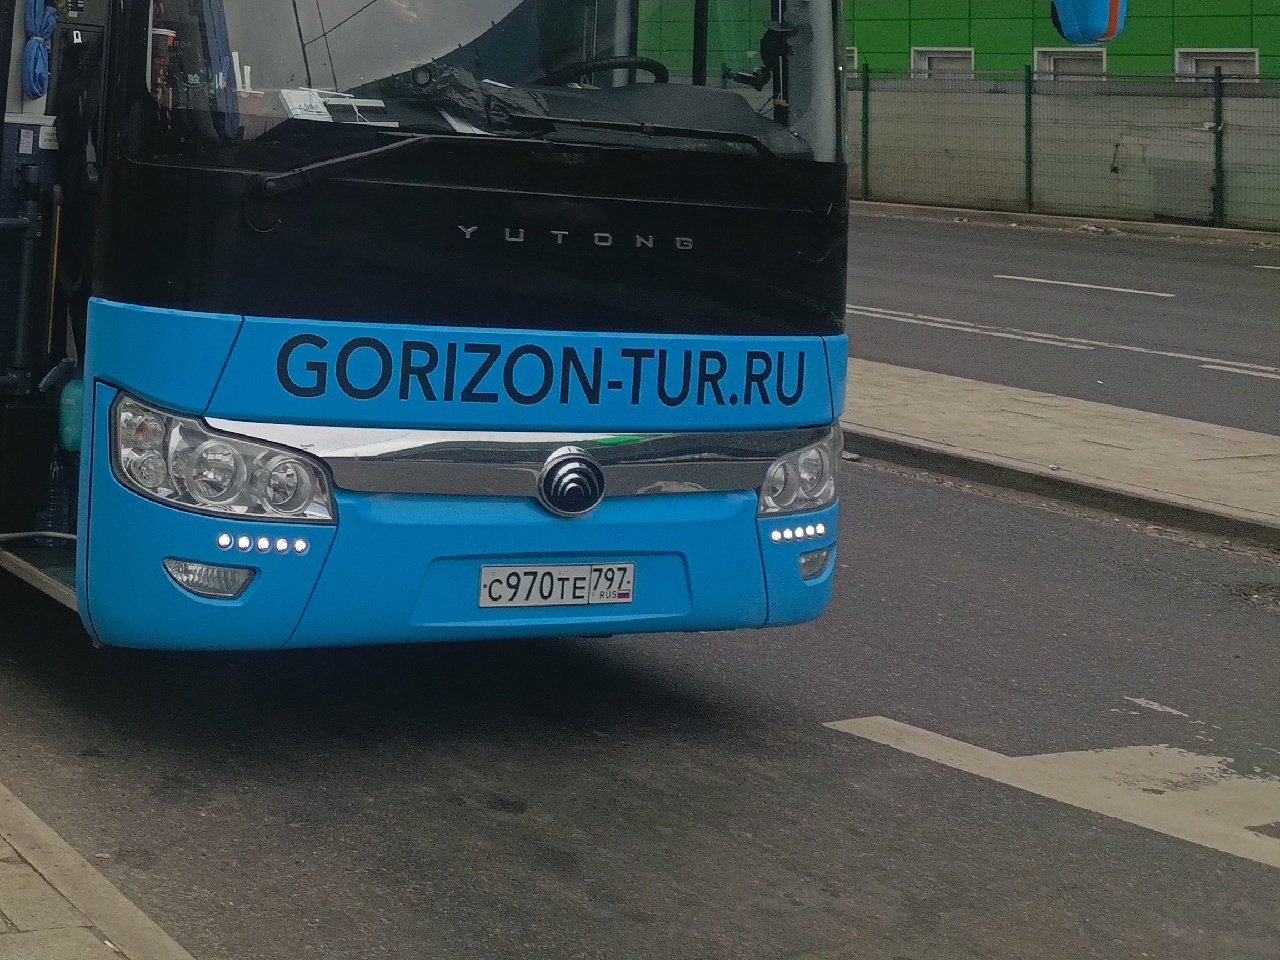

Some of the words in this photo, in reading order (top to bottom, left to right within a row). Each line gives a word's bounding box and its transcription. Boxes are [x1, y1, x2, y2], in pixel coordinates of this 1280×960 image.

[457, 225, 694, 250] YUTONG
[276, 333, 806, 407] GORIZON-TUR.RU
[592, 567, 628, 591] 797
[599, 590, 618, 599] RUS
